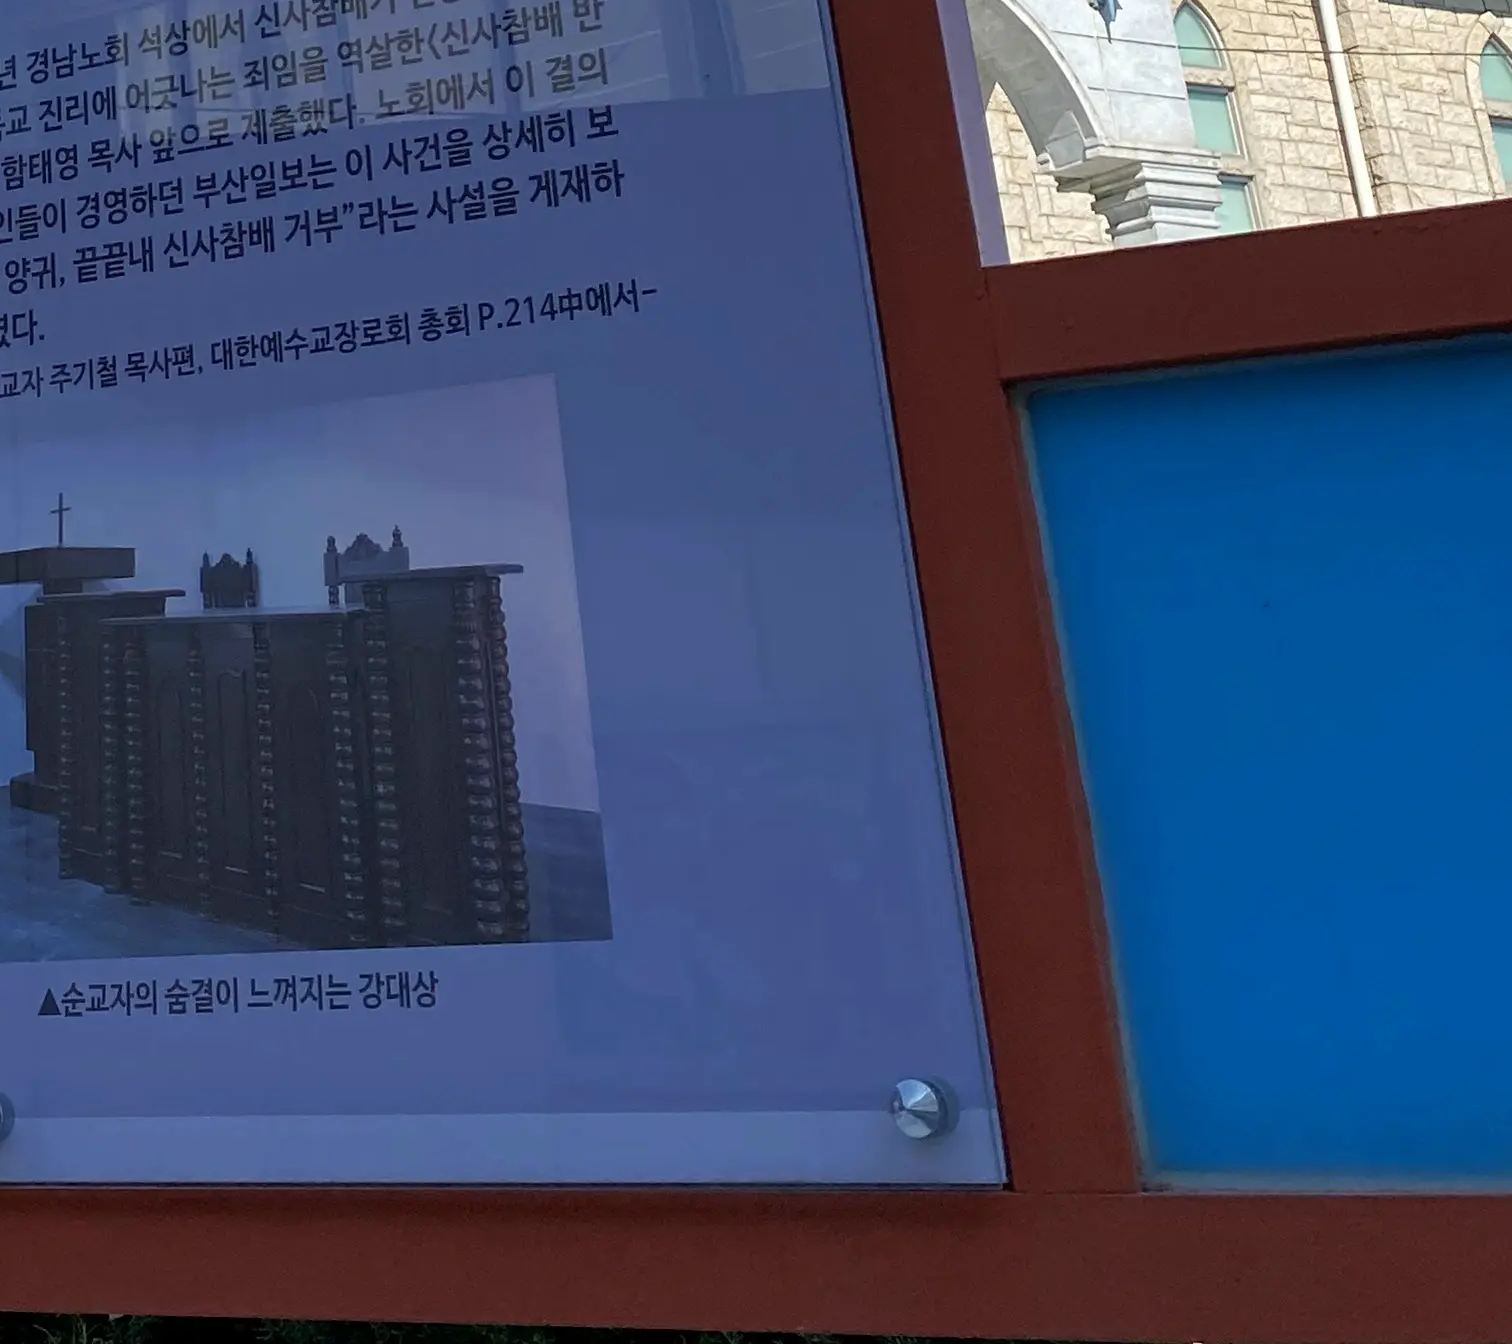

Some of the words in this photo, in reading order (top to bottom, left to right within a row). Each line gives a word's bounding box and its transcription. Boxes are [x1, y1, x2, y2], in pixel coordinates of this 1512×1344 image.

[26, 31, 130, 85] 경남노회
[138, 9, 245, 59] 석상에서
[38, 85, 118, 132] 진리에
[125, 65, 236, 115] 어긋나는
[243, 45, 329, 93] 죄임을
[1, 144, 79, 188] 함태영
[87, 133, 142, 174] 목사
[150, 118, 234, 165] 앞으로
[241, 92, 368, 145] 제출했다.
[376, 72, 496, 122] 노회에서
[504, 60, 535, 98] 이
[545, 48, 609, 94] 결의
[75, 178, 184, 231] 경영하던
[192, 152, 337, 211] 부산일보는
[345, 144, 372, 182] 이
[382, 127, 474, 177] 사건을
[482, 108, 575, 161] 상세히
[585, 104, 619, 140] 보
[4, 253, 66, 294] 양귀,
[73, 236, 154, 285] 끝끝내
[163, 216, 275, 269] 신사참배
[426, 176, 520, 227] 사설을
[528, 158, 625, 213] 게재하
[49, 356, 118, 396] 주기철
[124, 342, 204, 383] 목사편,
[210, 311, 412, 373] 대한예수교장로회
[417, 302, 471, 343] 총회
[61, 979, 158, 1018] 순교자의
[164, 976, 240, 1014] 숨결이
[247, 973, 352, 1011] 느껴지는
[358, 970, 439, 1010] 강대상
